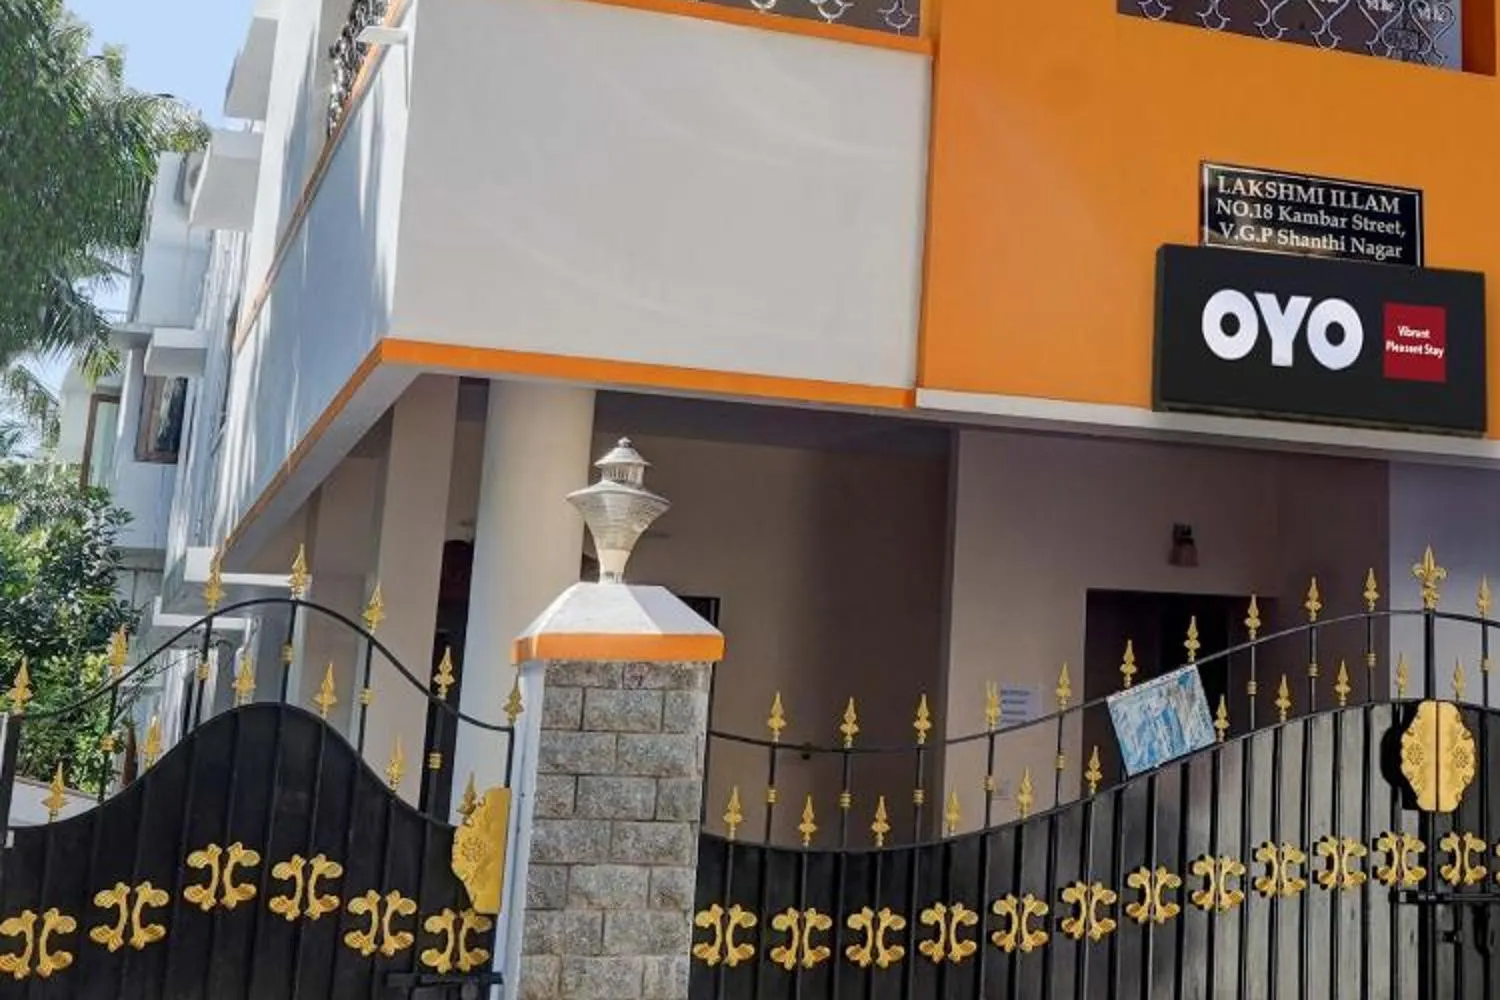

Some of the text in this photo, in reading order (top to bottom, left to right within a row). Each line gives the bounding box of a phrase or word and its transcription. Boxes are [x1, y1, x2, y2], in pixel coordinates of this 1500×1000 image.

[1218, 175, 1400, 214] LAKSHMI ILLAM
[1216, 198, 1405, 238] NO.18 Kambar Street,
[1219, 222, 1402, 260] V.G.P Shanthi Nagar
[1202, 289, 1363, 370] OYO
[1397, 325, 1430, 339] Vibrant
[1385, 340, 1444, 359] Pleasant Stay
